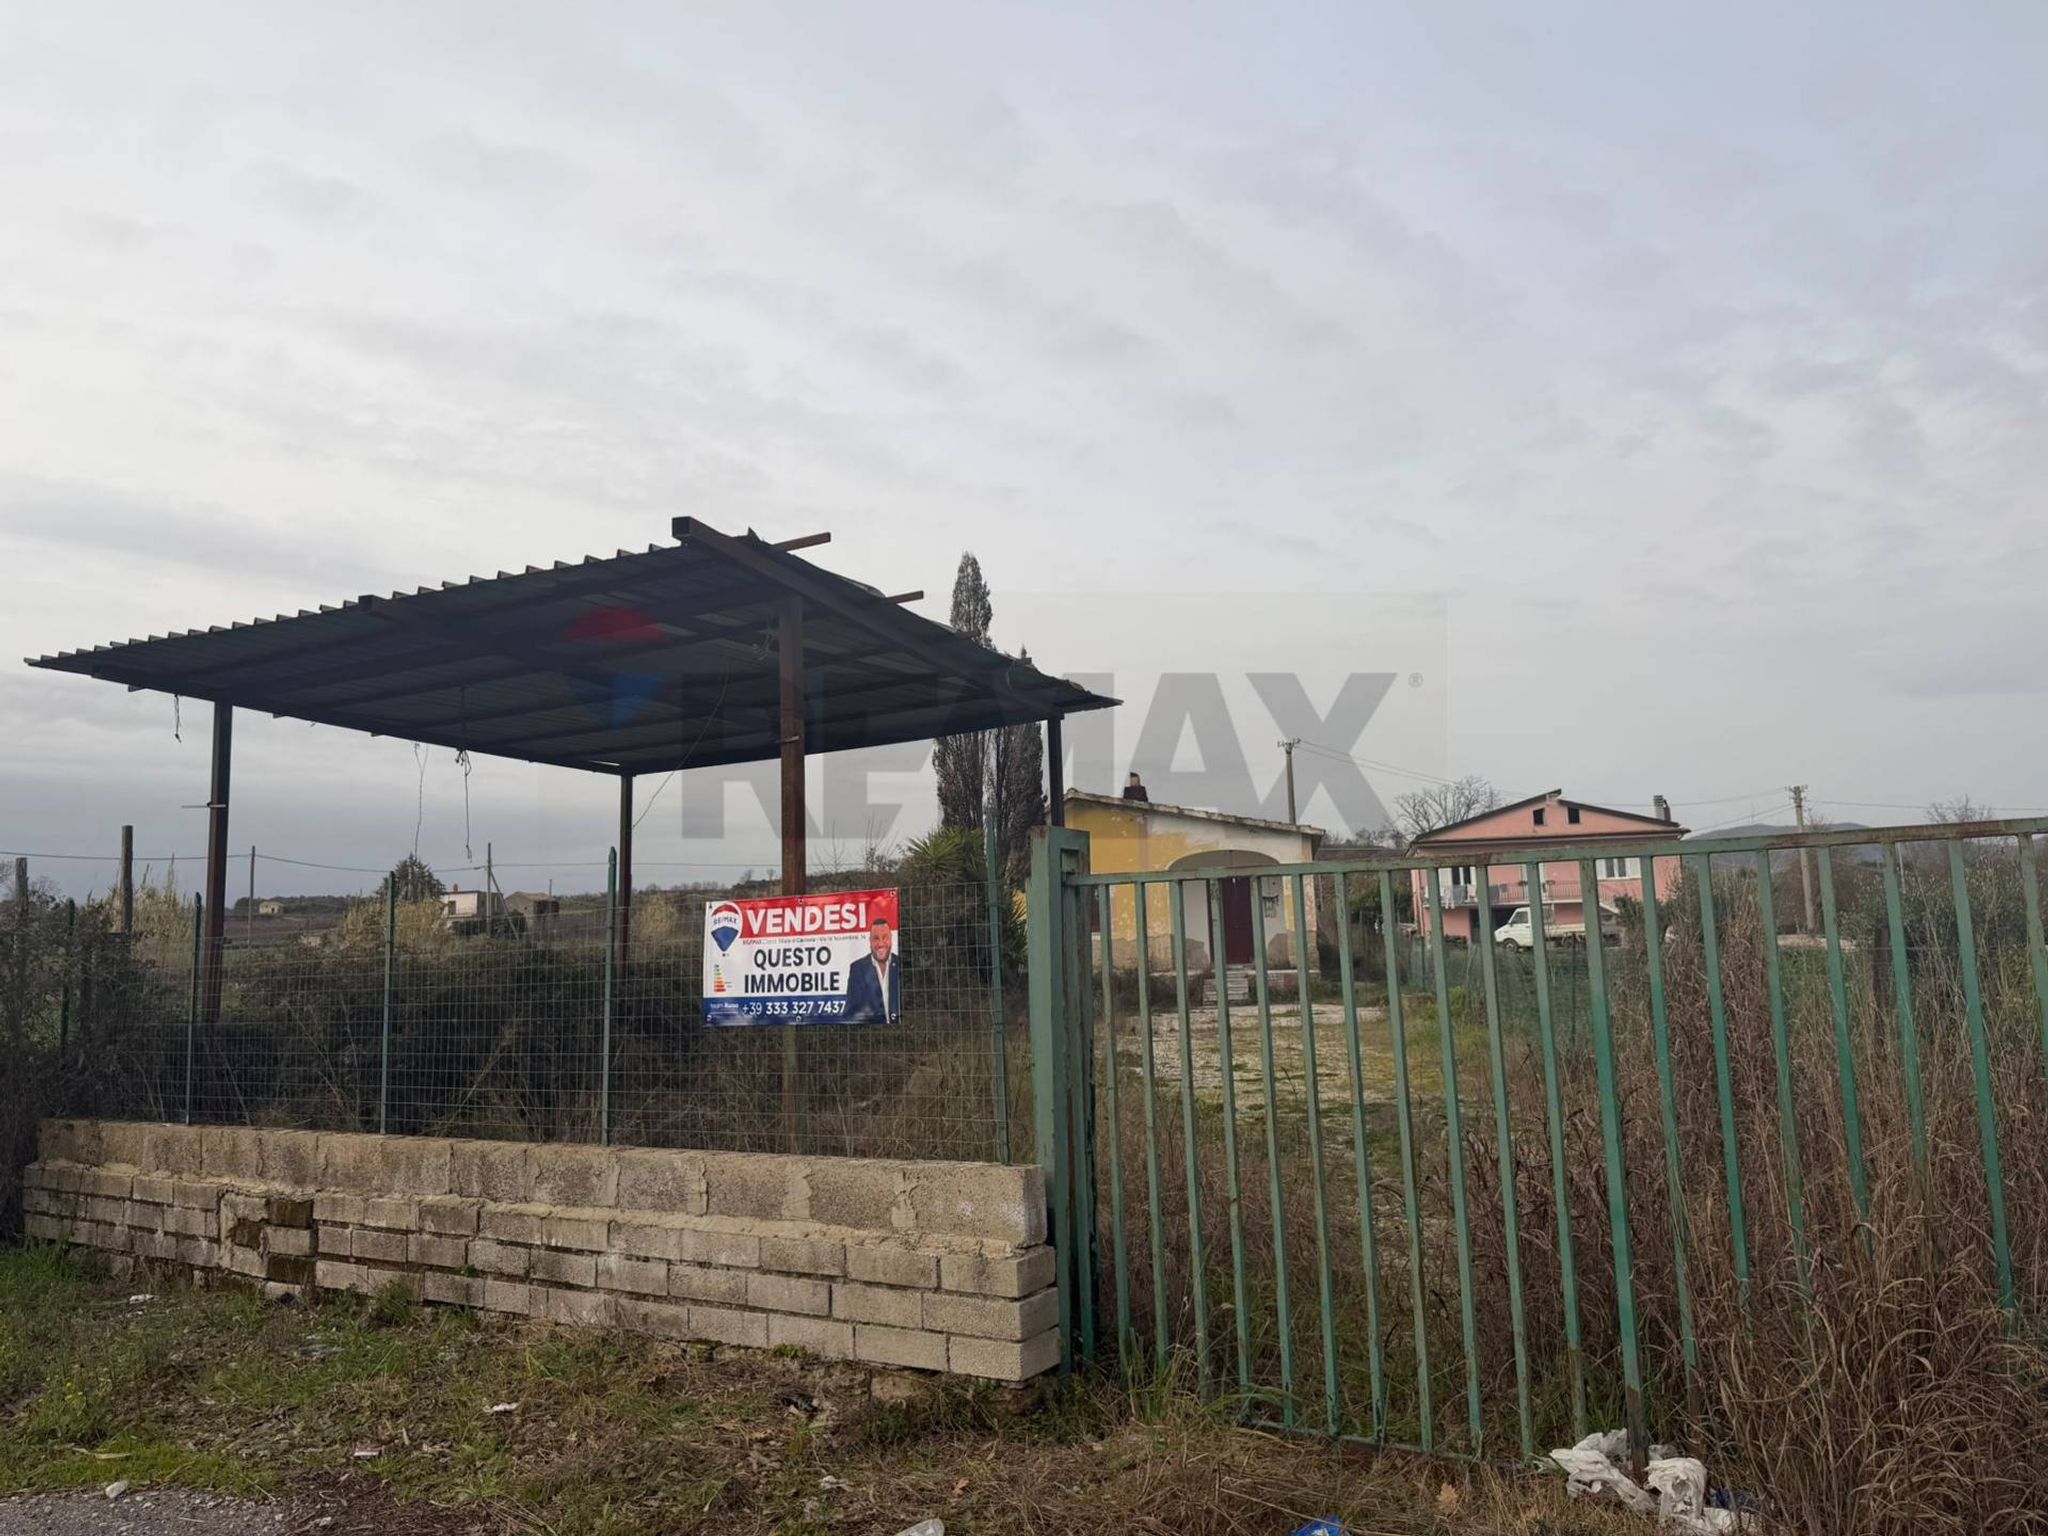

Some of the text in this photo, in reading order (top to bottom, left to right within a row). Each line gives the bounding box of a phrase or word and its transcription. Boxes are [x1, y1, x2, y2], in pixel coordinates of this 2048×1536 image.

[745, 902, 867, 935] VENDESI
[754, 946, 831, 970] QUESTO
[744, 971, 840, 993] IMMOBILE
[742, 1003, 763, 1015] +39
[766, 1002, 789, 1015] 333
[792, 1001, 814, 1014] 327
[817, 1000, 846, 1014] 7437
